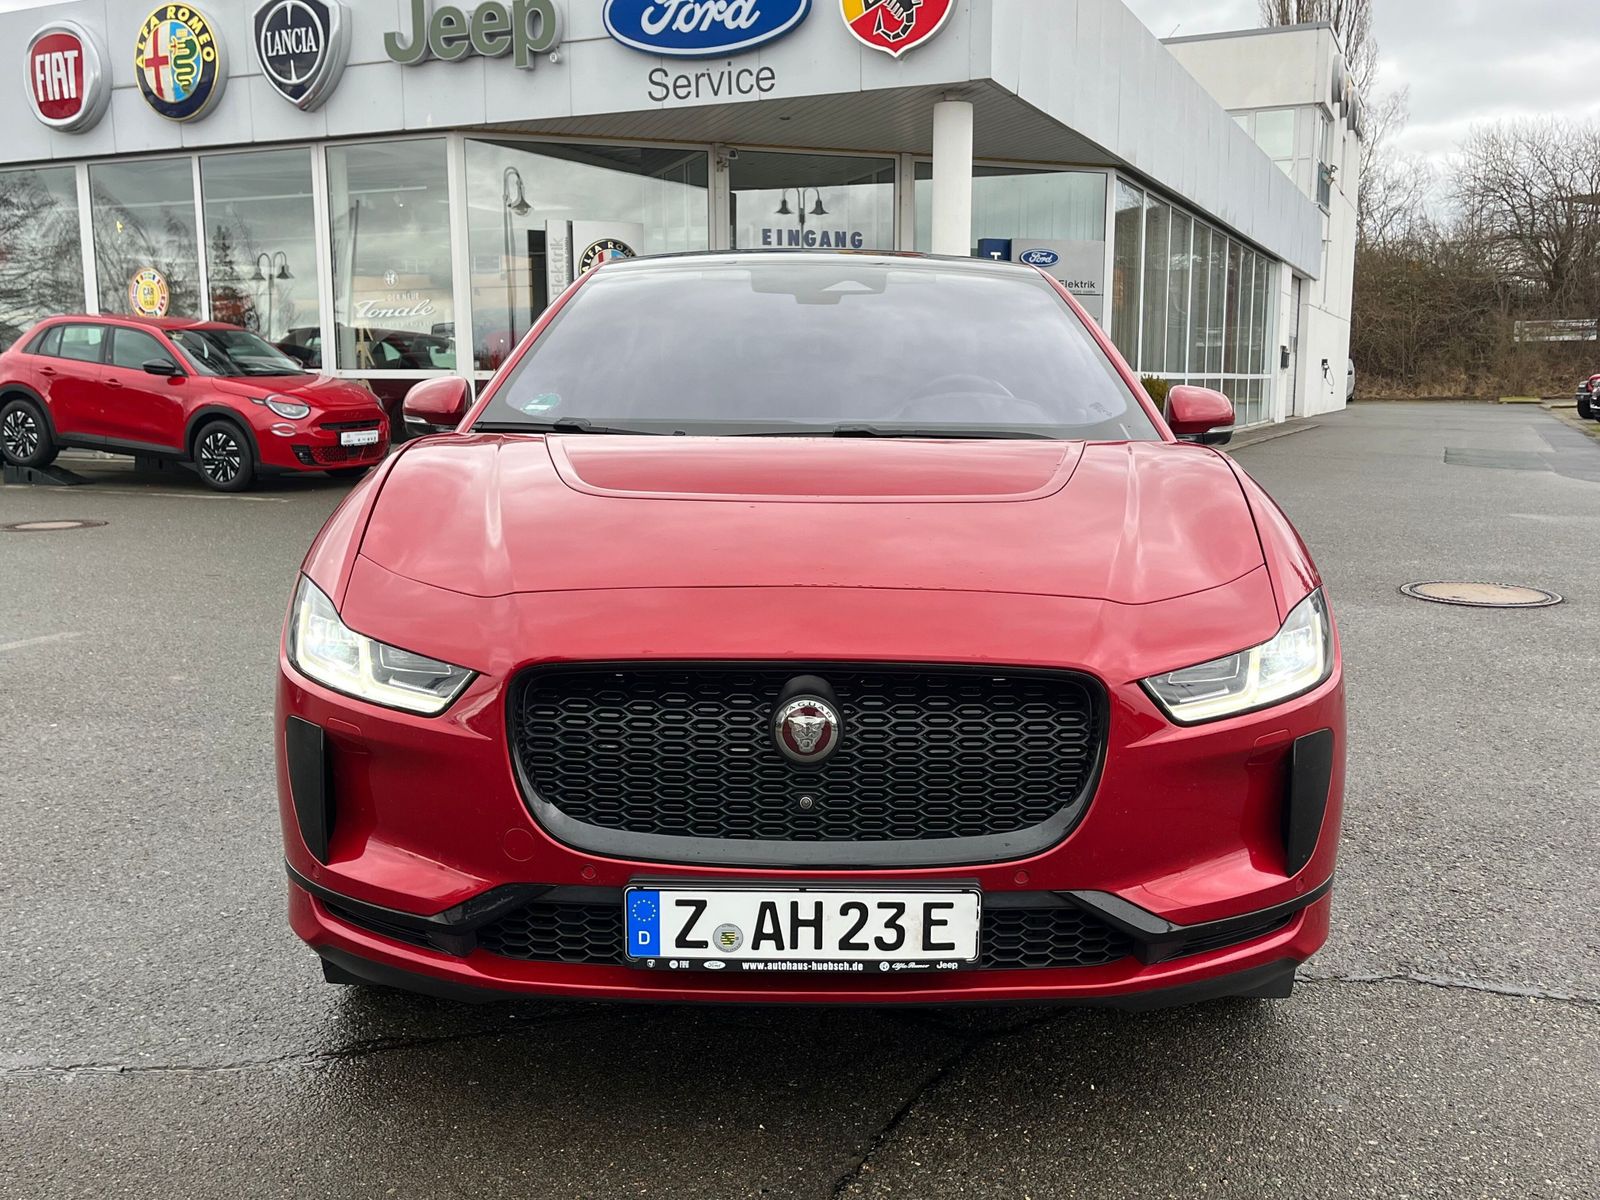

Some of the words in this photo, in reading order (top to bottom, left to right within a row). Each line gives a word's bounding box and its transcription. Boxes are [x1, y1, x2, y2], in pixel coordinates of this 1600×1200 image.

[640, 0, 761, 36] Ford
[136, 17, 160, 69] ALFA
[166, 5, 215, 63] ROMEO
[266, 26, 319, 57] LANCIA
[383, 0, 557, 69] Jeep
[35, 50, 79, 103] FIAT
[648, 61, 776, 102] Service
[762, 228, 863, 249] EINGANG
[581, 245, 603, 272] ALFA
[607, 241, 634, 258] ROM
[1028, 251, 1053, 263] Ford
[354, 298, 436, 318] Tonale
[638, 931, 650, 944] D
[675, 899, 709, 948] Z
[751, 900, 823, 950] AH
[838, 901, 906, 951] 23
[922, 902, 955, 951] E
[742, 961, 864, 971] www.autohaus-huebsch.de
[936, 961, 958, 970] Jeep
